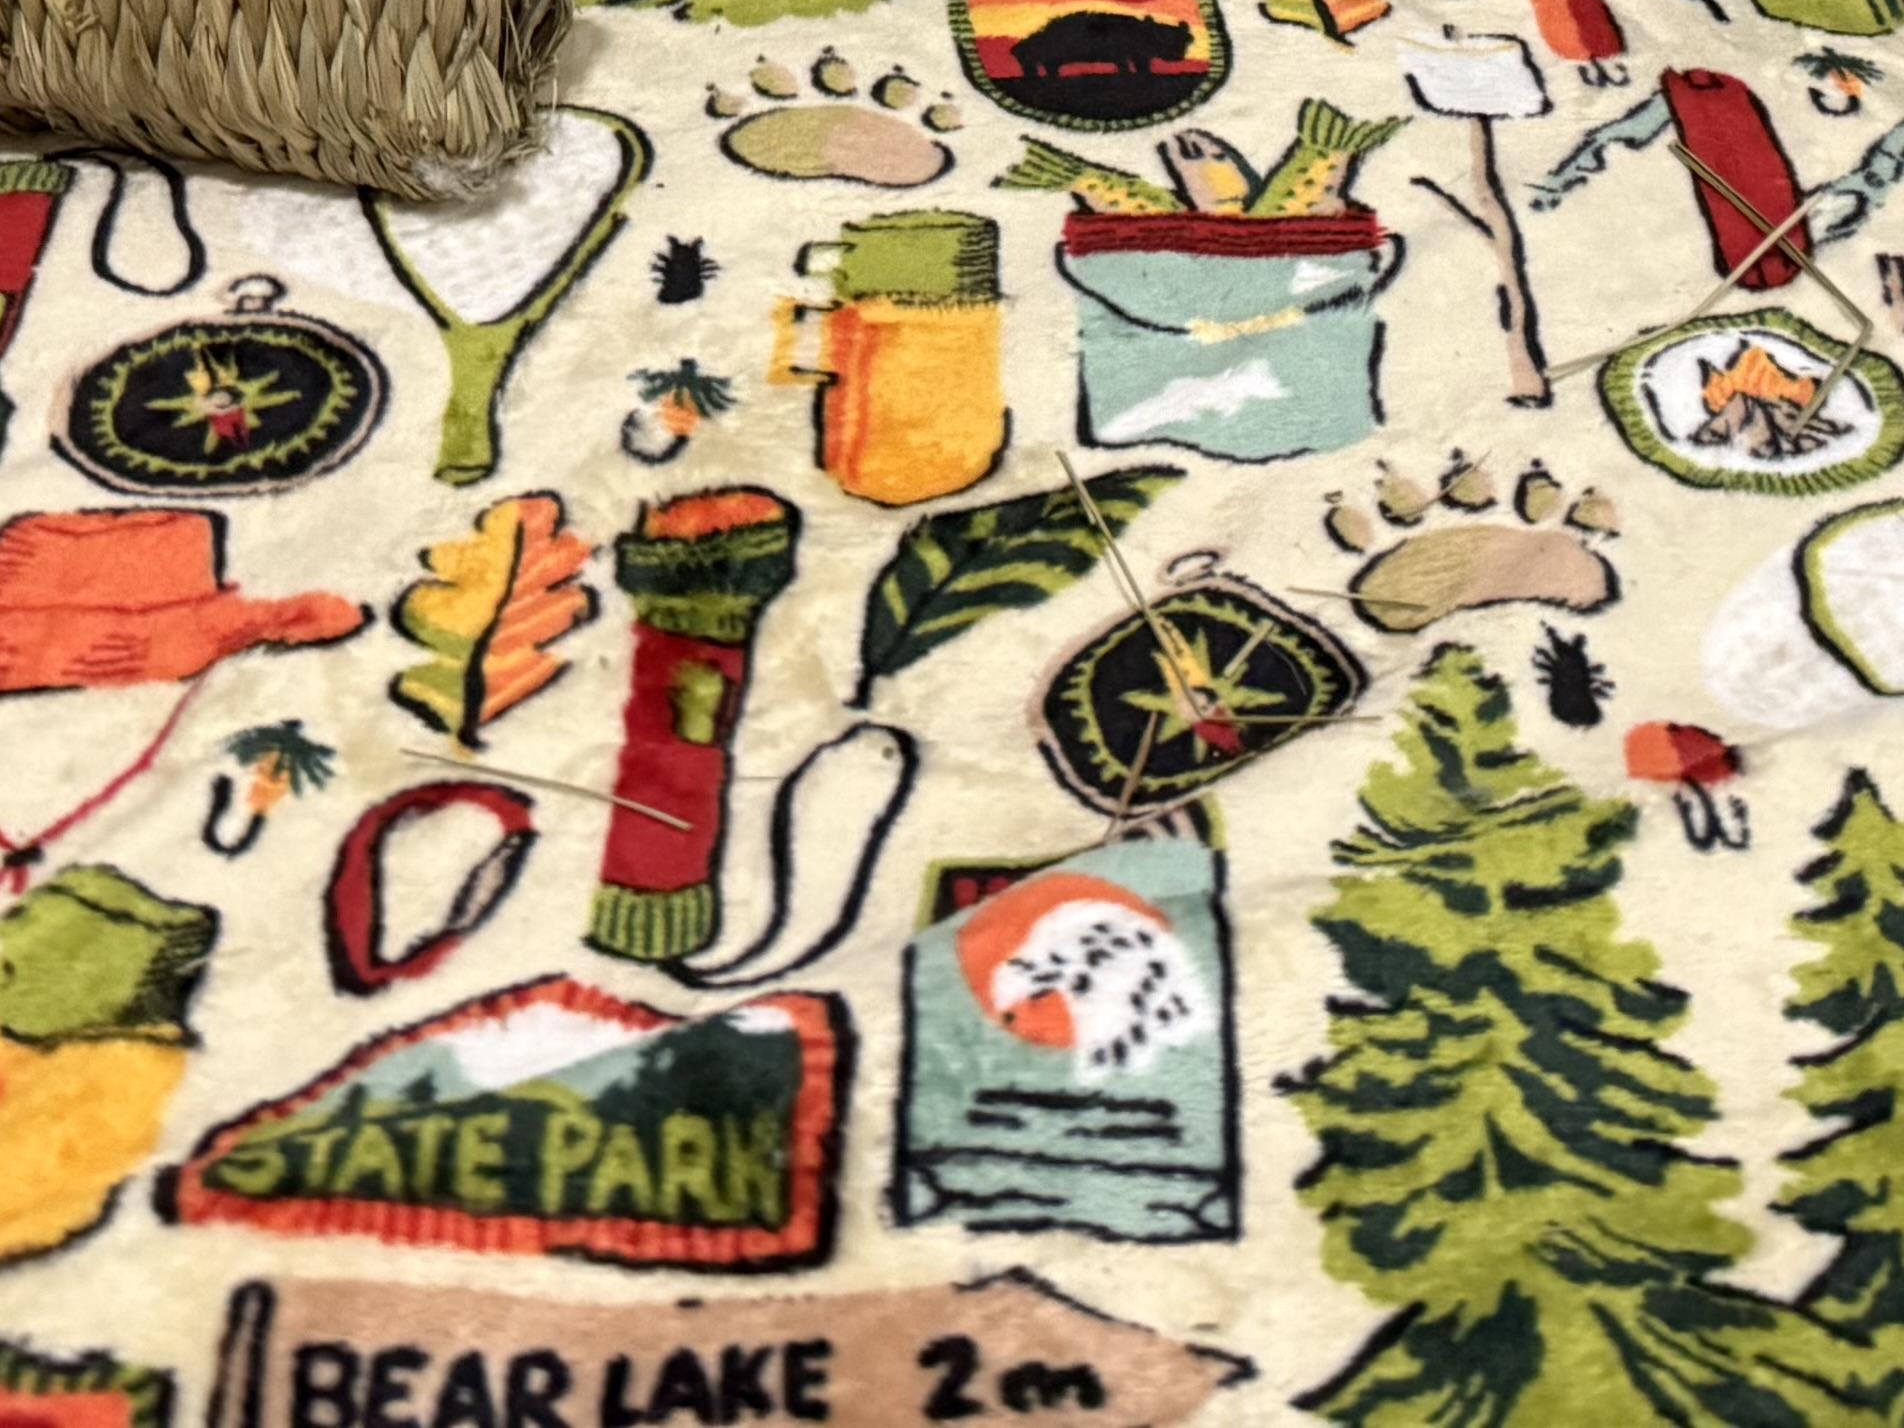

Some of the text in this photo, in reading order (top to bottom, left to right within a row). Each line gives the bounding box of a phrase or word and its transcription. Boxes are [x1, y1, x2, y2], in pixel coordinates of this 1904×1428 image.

[216, 1109, 788, 1232] STATE PARK
[289, 1340, 573, 1428] BEAR
[598, 1338, 834, 1428] LAKE
